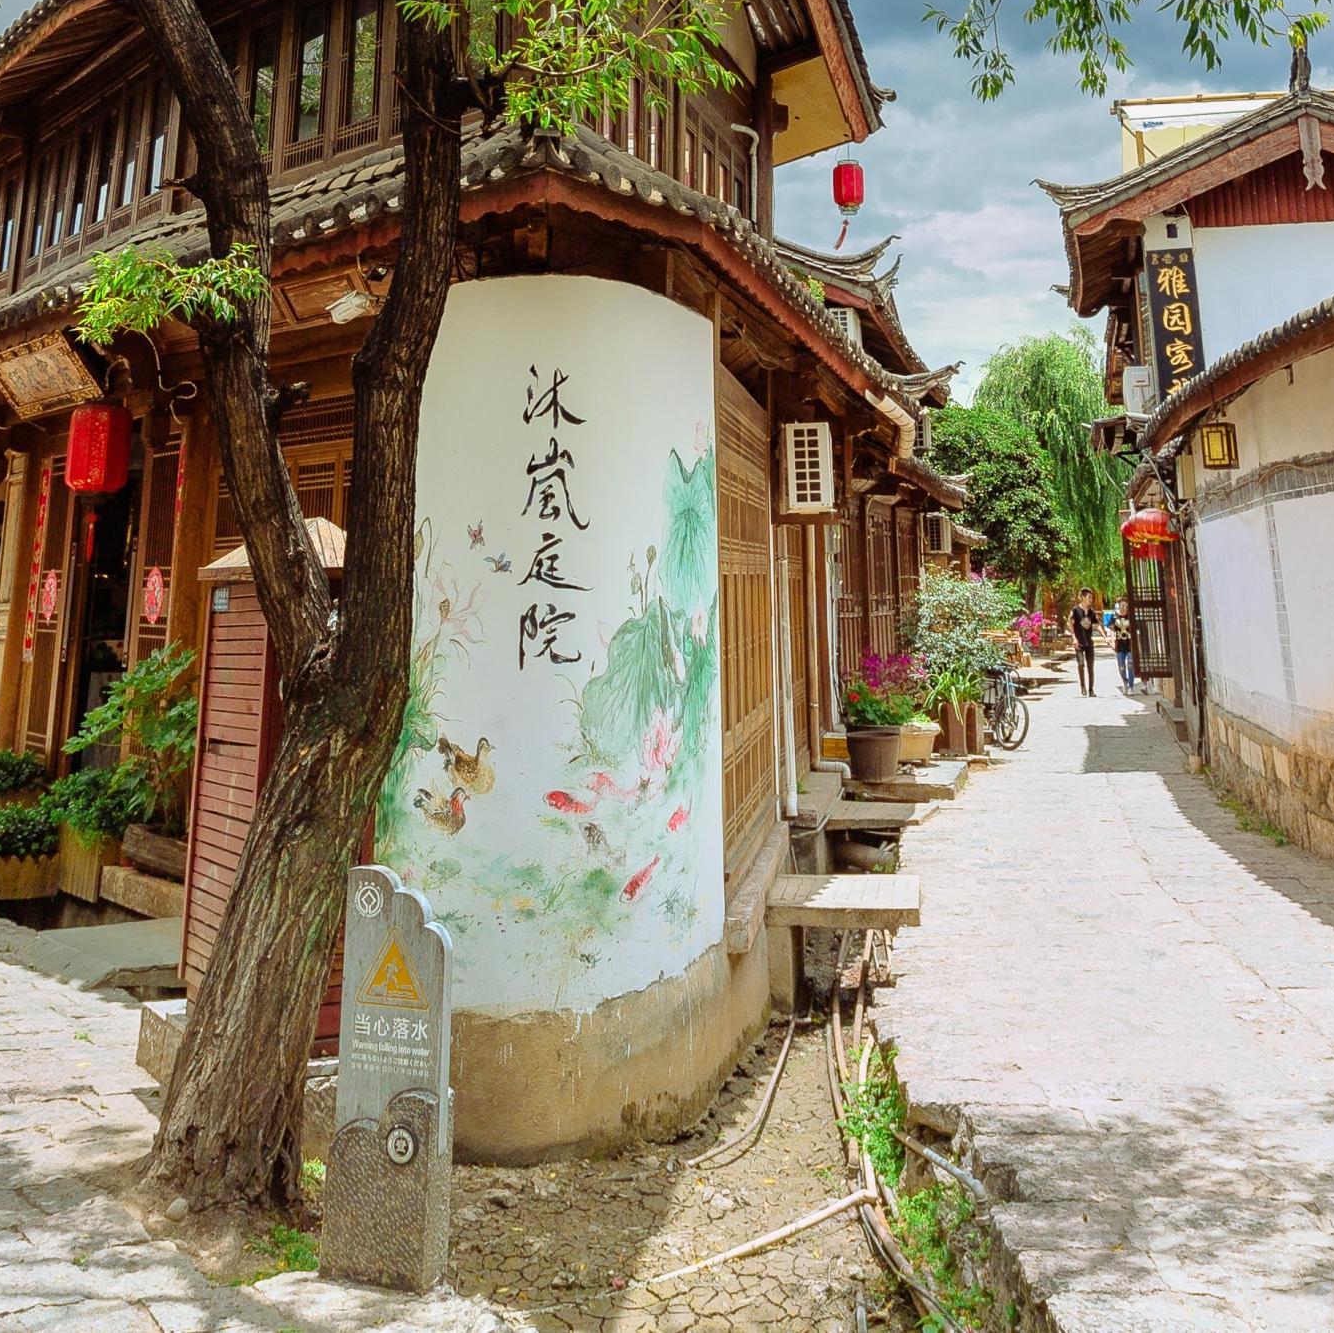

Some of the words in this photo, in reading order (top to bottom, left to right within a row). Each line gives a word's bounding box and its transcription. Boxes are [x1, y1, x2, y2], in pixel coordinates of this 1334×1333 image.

[354, 1013, 428, 1041] 当心落水
[352, 1039, 378, 1053] Warning
[378, 1042, 398, 1055] falling
[411, 1047, 430, 1057] water
